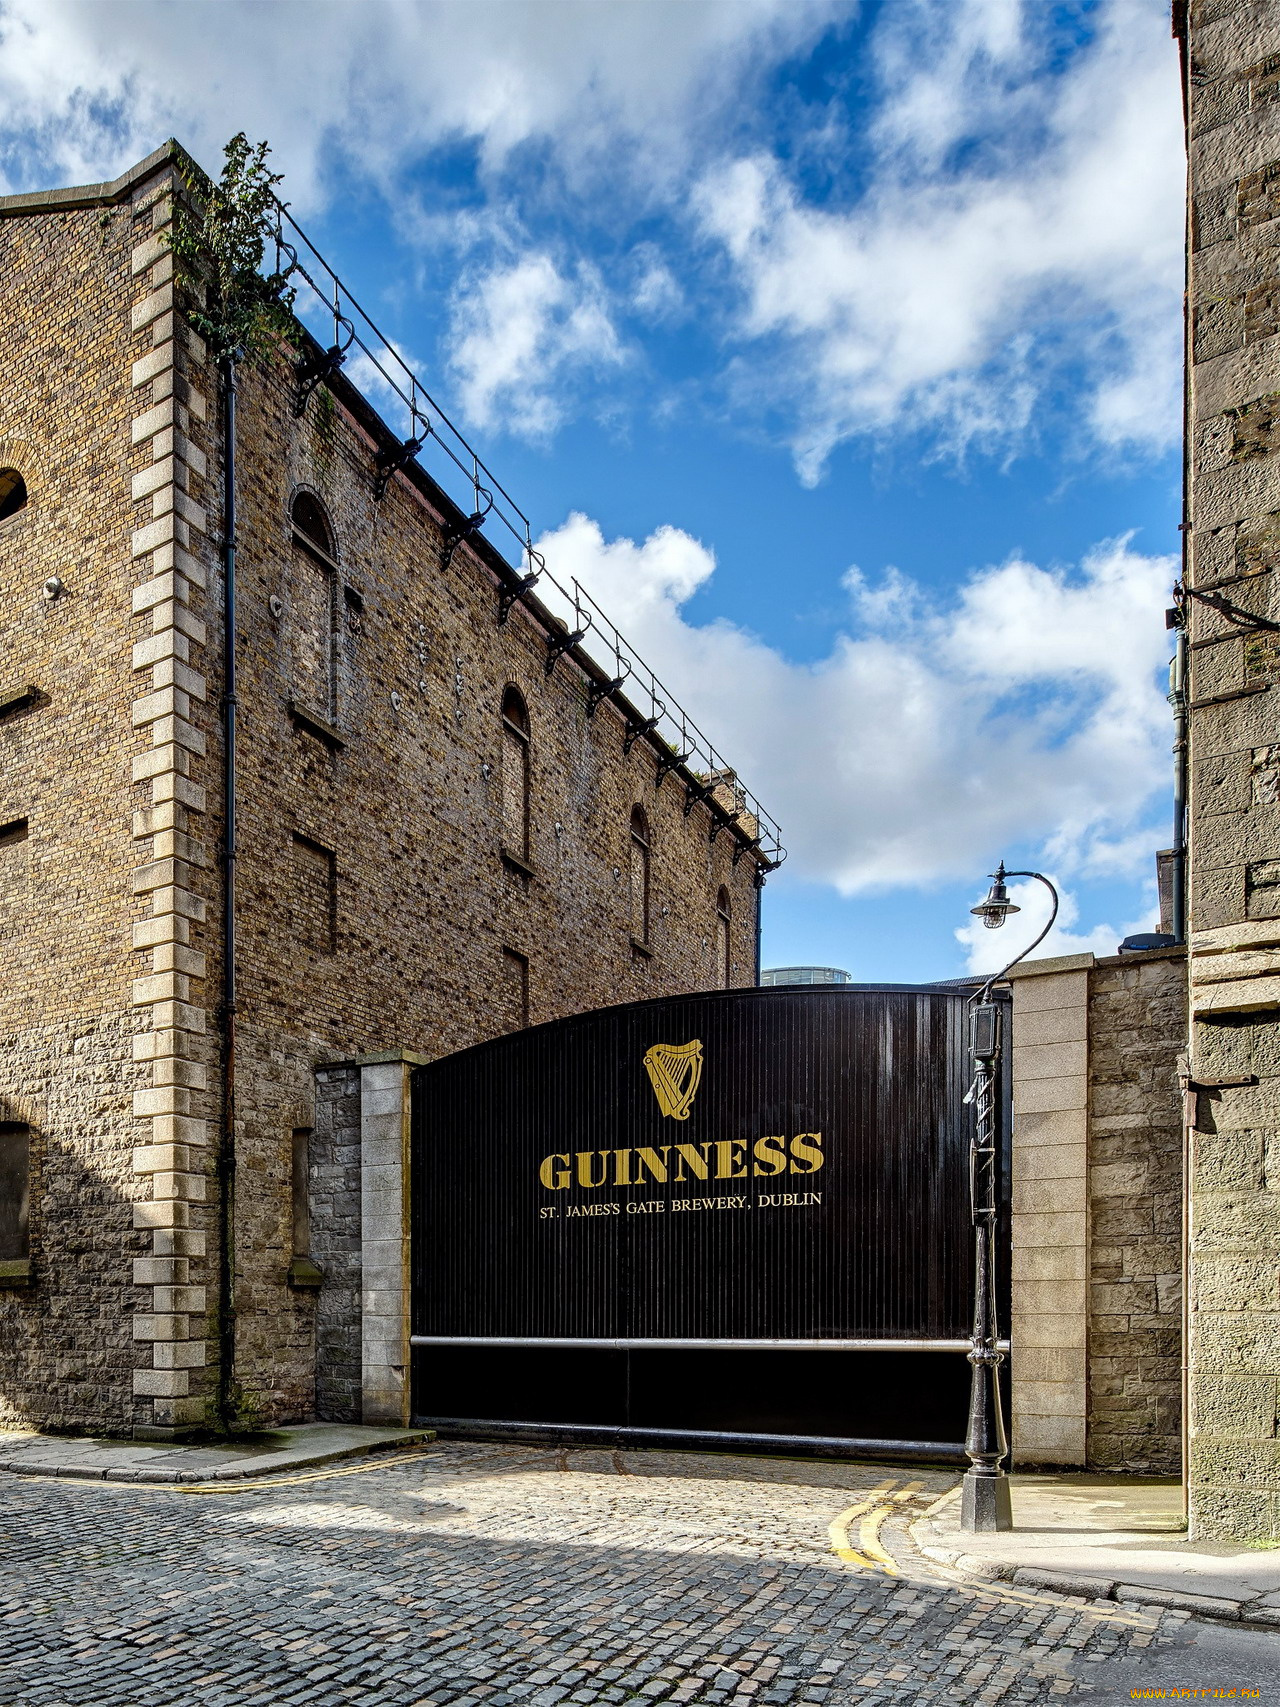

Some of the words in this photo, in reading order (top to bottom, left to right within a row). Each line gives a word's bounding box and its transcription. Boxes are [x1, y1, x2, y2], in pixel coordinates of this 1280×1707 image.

[539, 1132, 824, 1190] GUINNESS
[540, 1206, 560, 1219] ST.
[566, 1202, 620, 1217] JAMES'S
[626, 1200, 665, 1214] GATE
[672, 1195, 751, 1212] BREWERY,
[758, 1192, 822, 1208] DUBLIN
